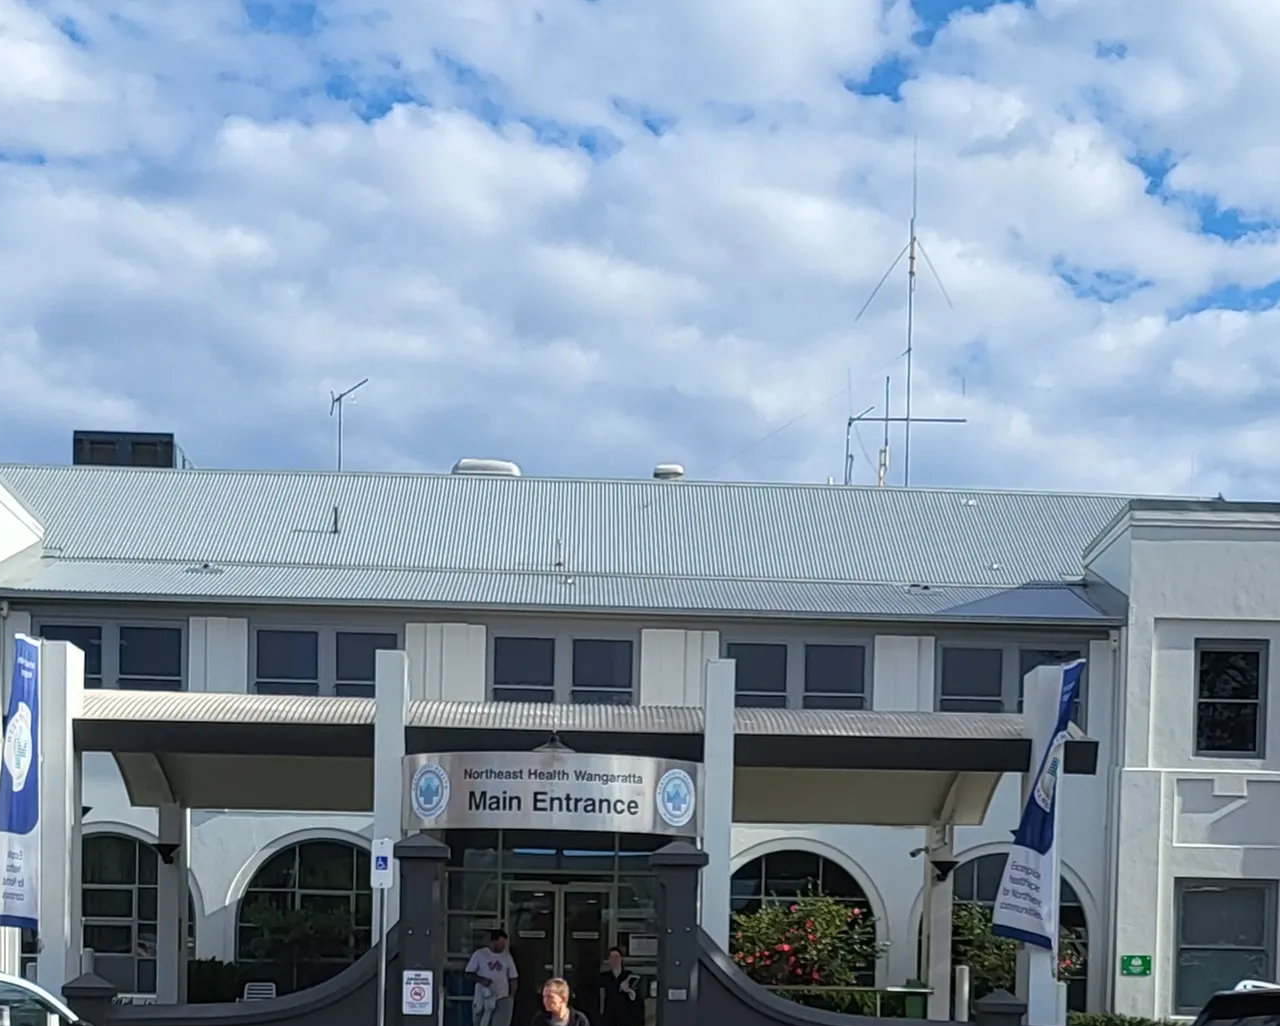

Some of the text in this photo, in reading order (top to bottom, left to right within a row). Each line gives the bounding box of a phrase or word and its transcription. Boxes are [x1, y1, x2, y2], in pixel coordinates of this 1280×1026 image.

[463, 767, 524, 781] Northeast
[527, 768, 569, 782] Health
[573, 769, 643, 785] Wangaratta
[467, 790, 521, 812] Main
[532, 791, 639, 816] Entrance
